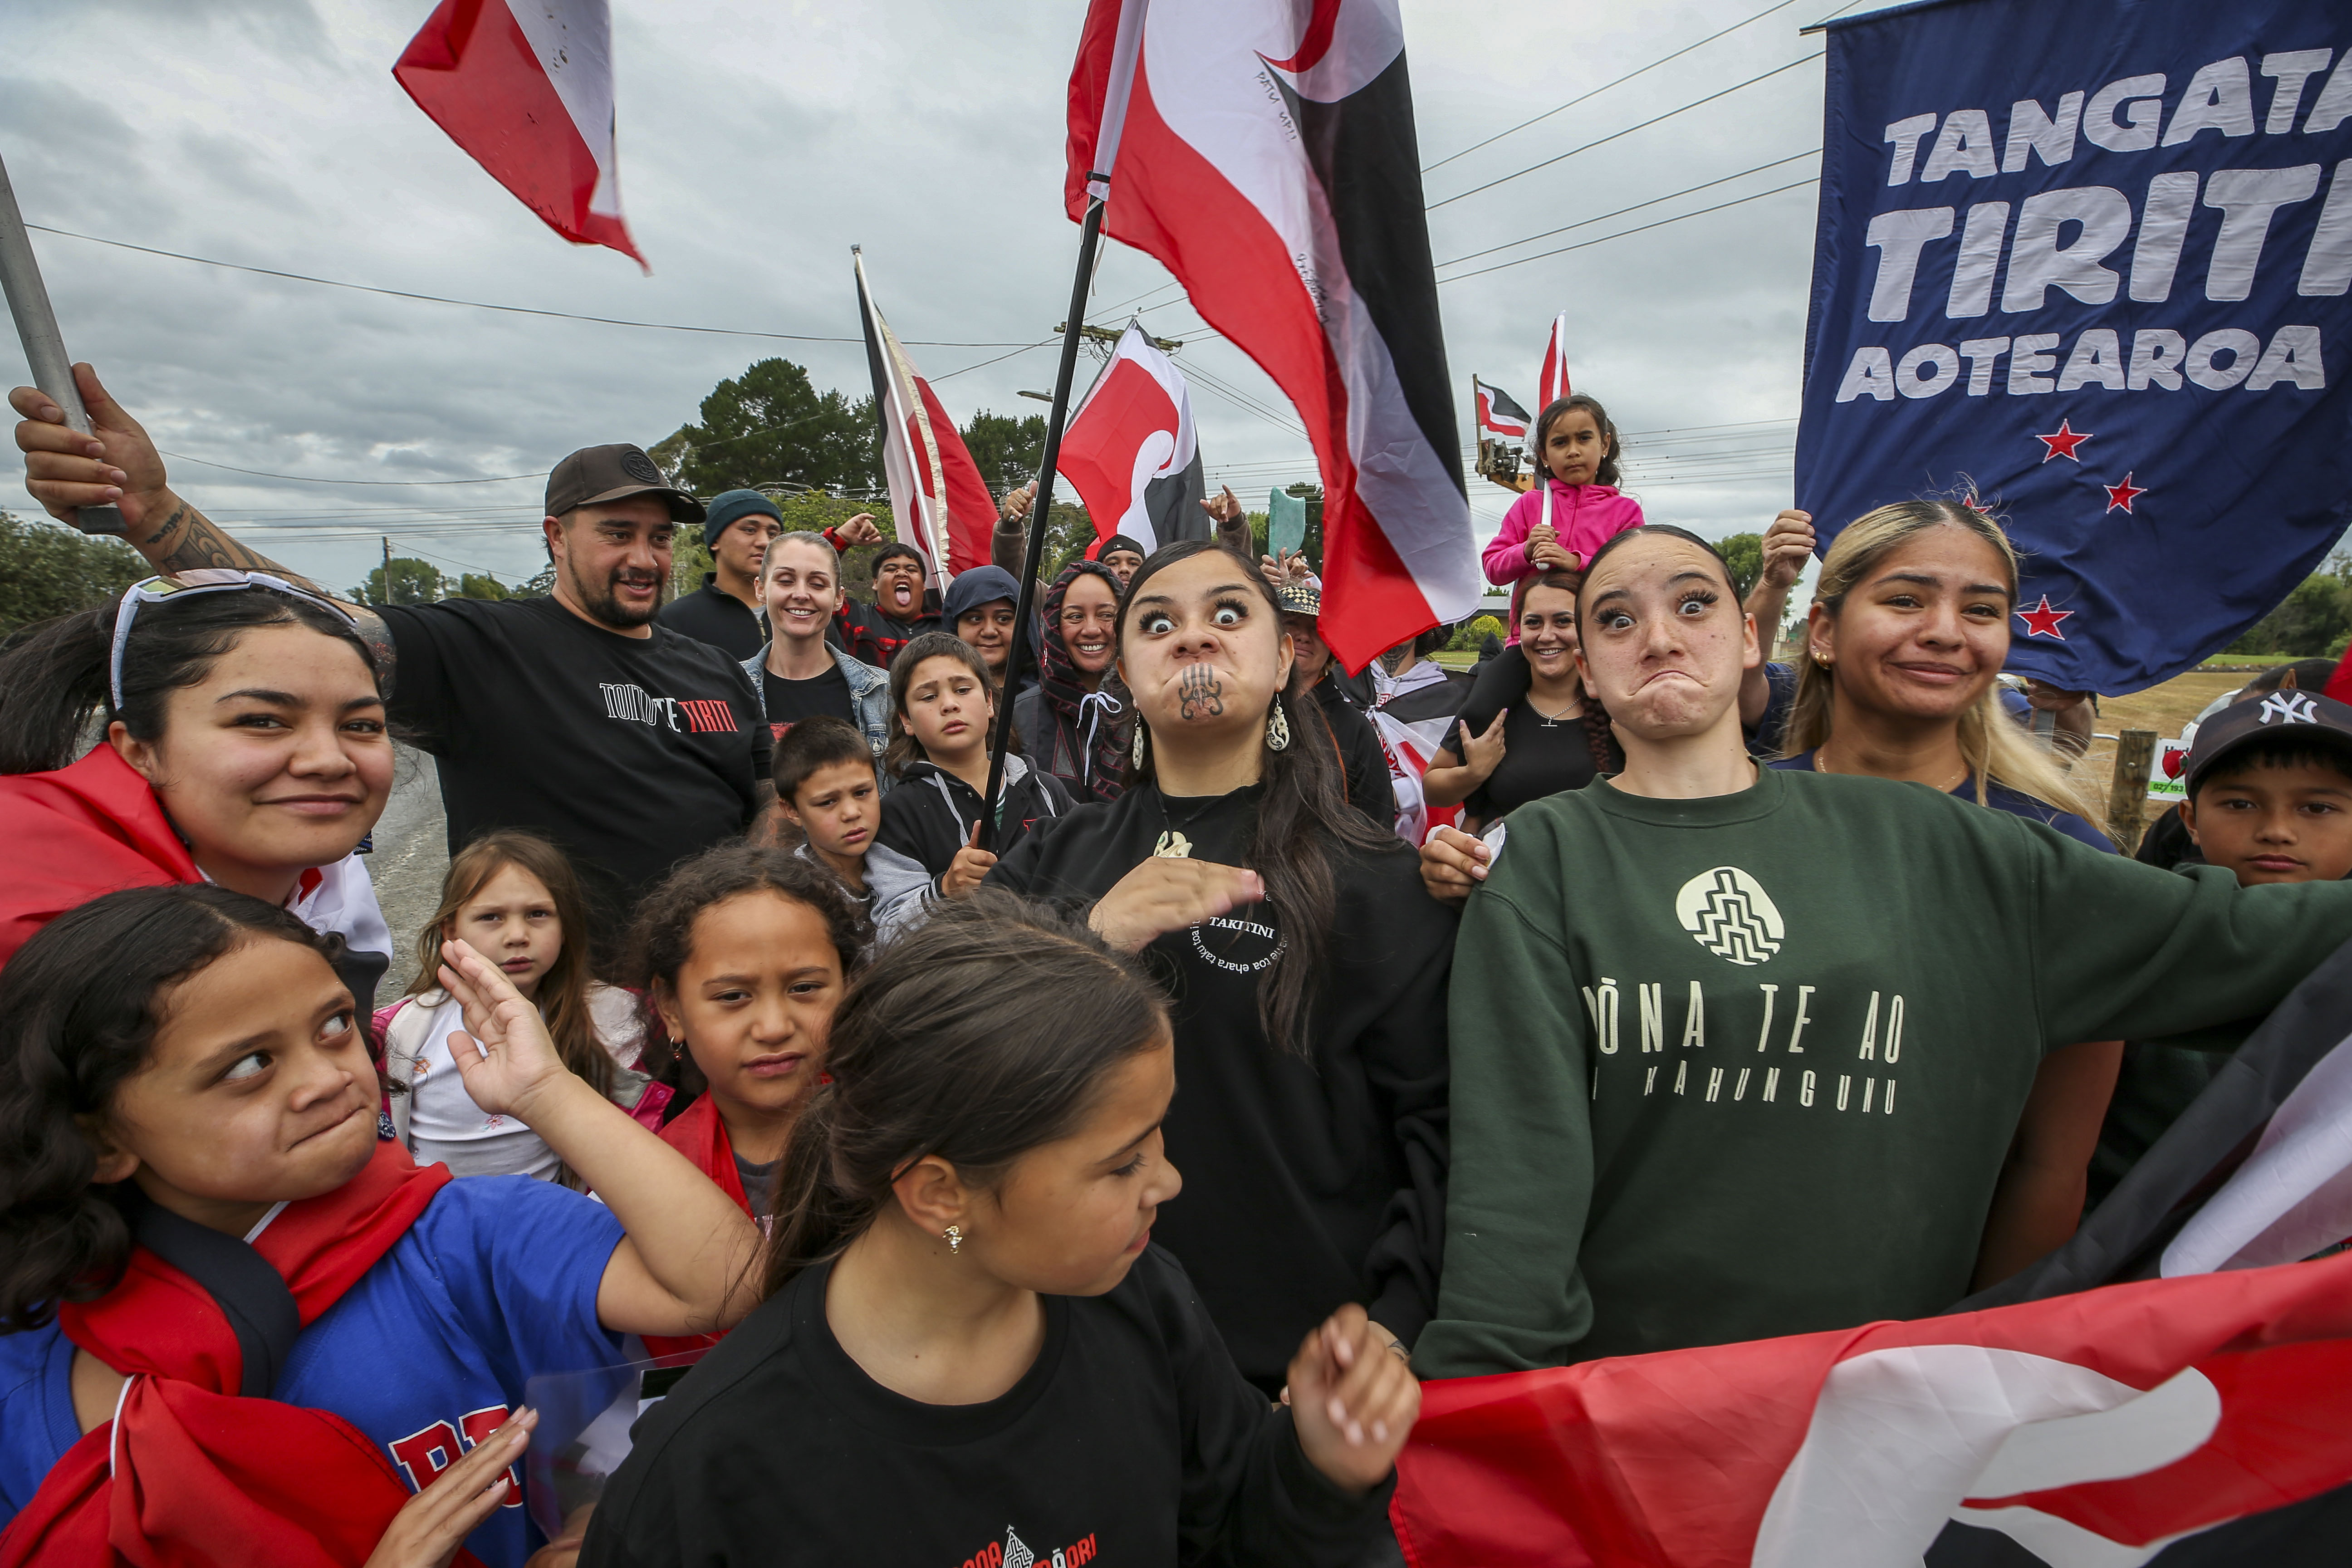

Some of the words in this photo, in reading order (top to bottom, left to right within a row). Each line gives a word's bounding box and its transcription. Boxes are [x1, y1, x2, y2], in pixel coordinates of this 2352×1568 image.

[1866, 158, 2352, 322] TIRITI
[1836, 325, 2325, 402] AOTEAROA
[677, 700, 739, 732] TIRITI
[2259, 691, 2318, 725] NY
[1191, 930, 1201, 946] toa
[1209, 916, 1275, 939] TAKITINI
[1197, 945, 1216, 964] taku
[1217, 958, 1250, 974] ehara
[1252, 957, 1271, 970] toa
[1757, 983, 1816, 1054] TE
[1858, 990, 1904, 1064] AO
[1644, 1060, 1896, 1115] KAHUNGUNU
